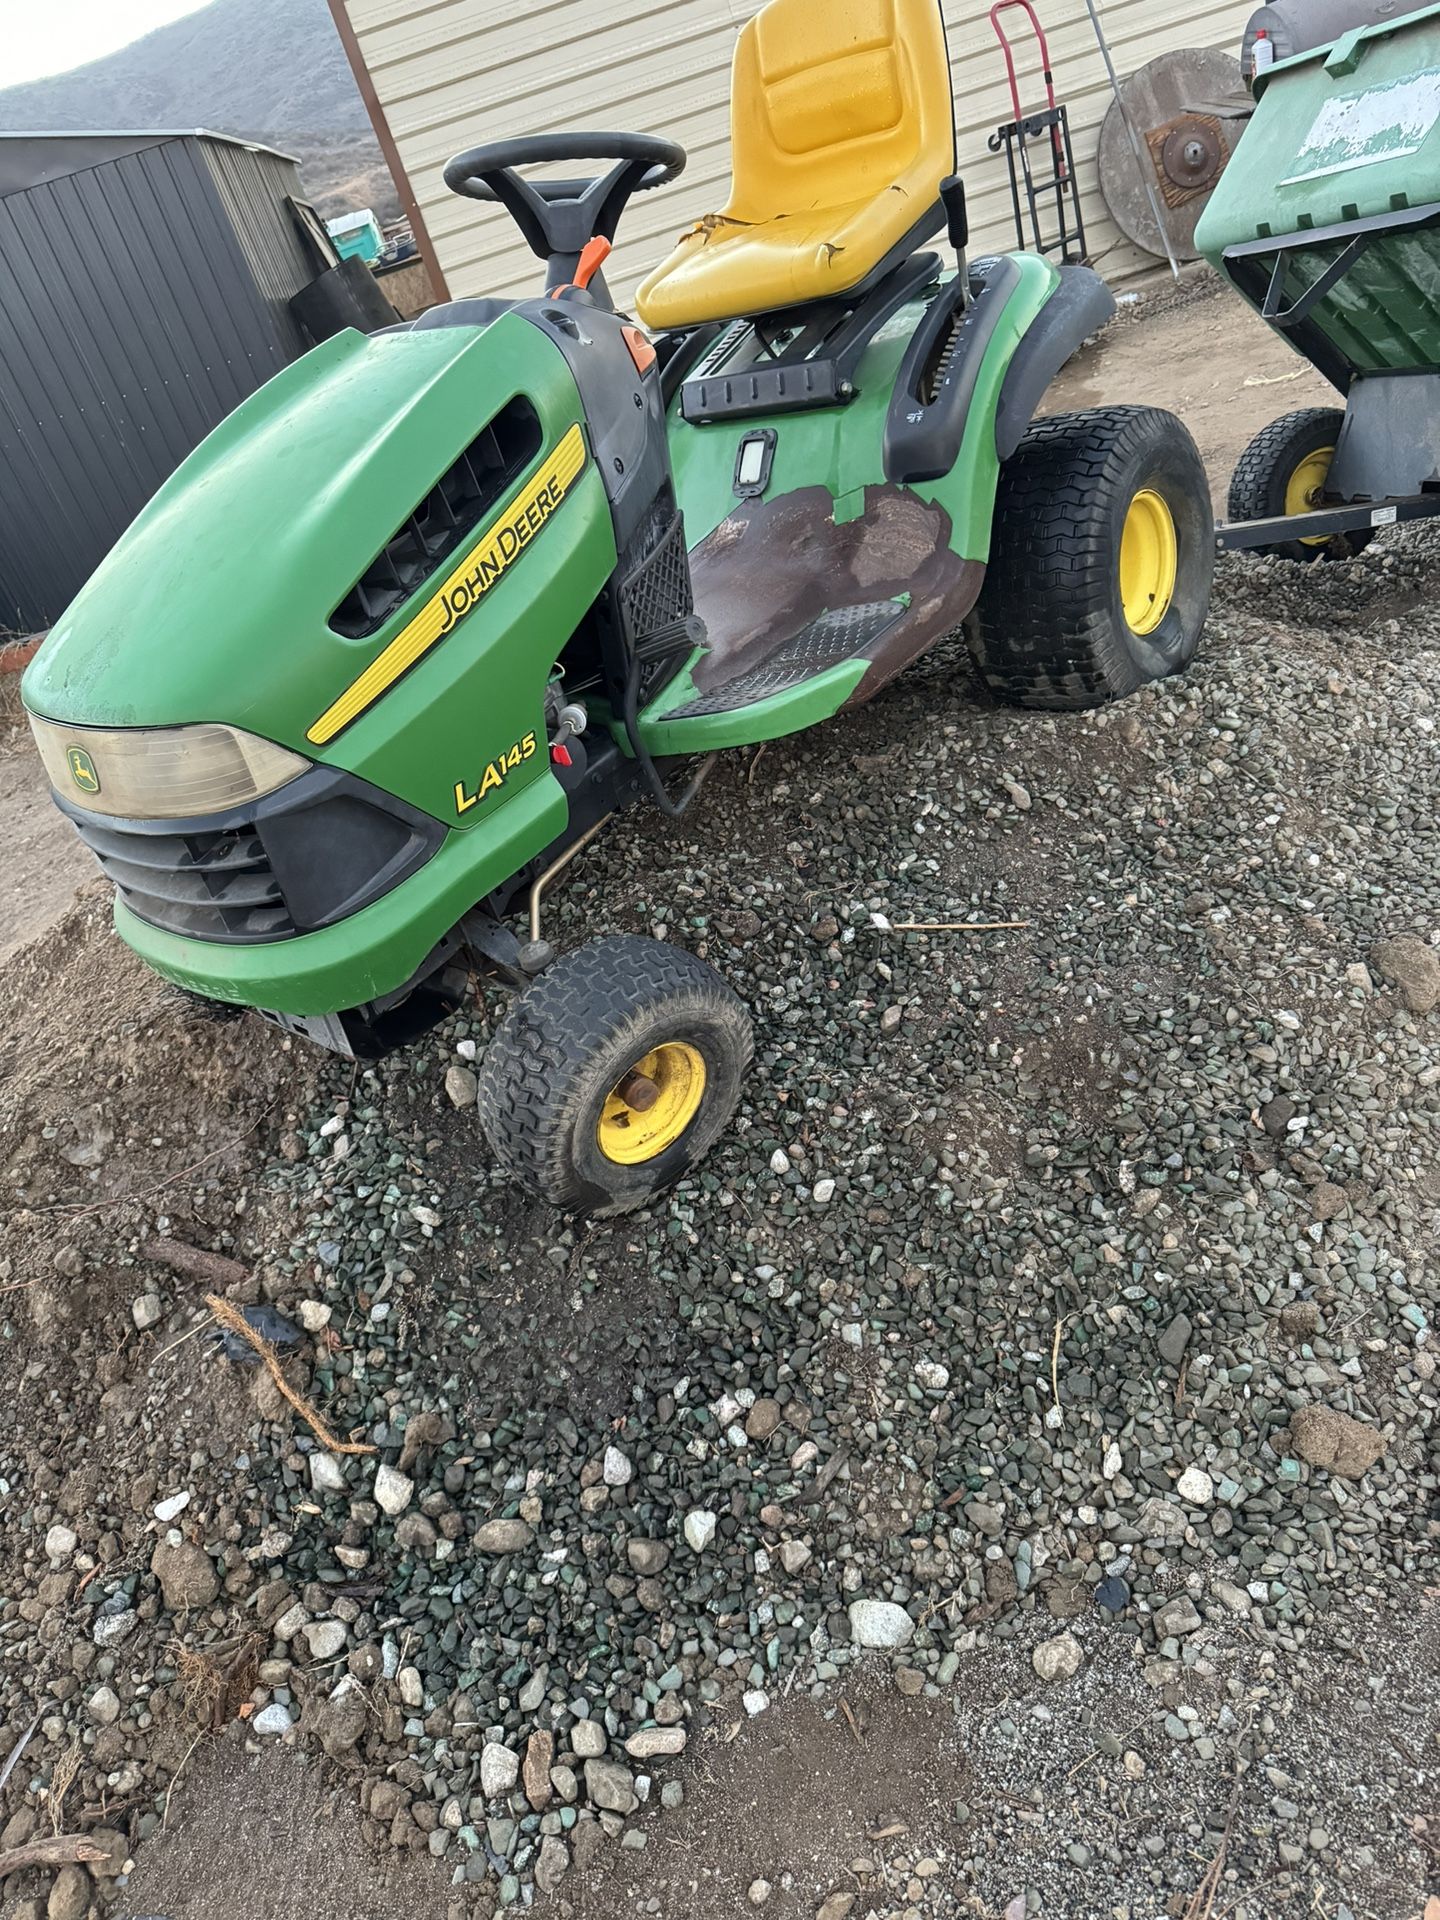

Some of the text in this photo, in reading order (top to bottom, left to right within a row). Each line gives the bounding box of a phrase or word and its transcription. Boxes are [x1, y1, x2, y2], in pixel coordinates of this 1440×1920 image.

[440, 473, 563, 631] JOHN DEERE
[454, 731, 537, 815] LA145
